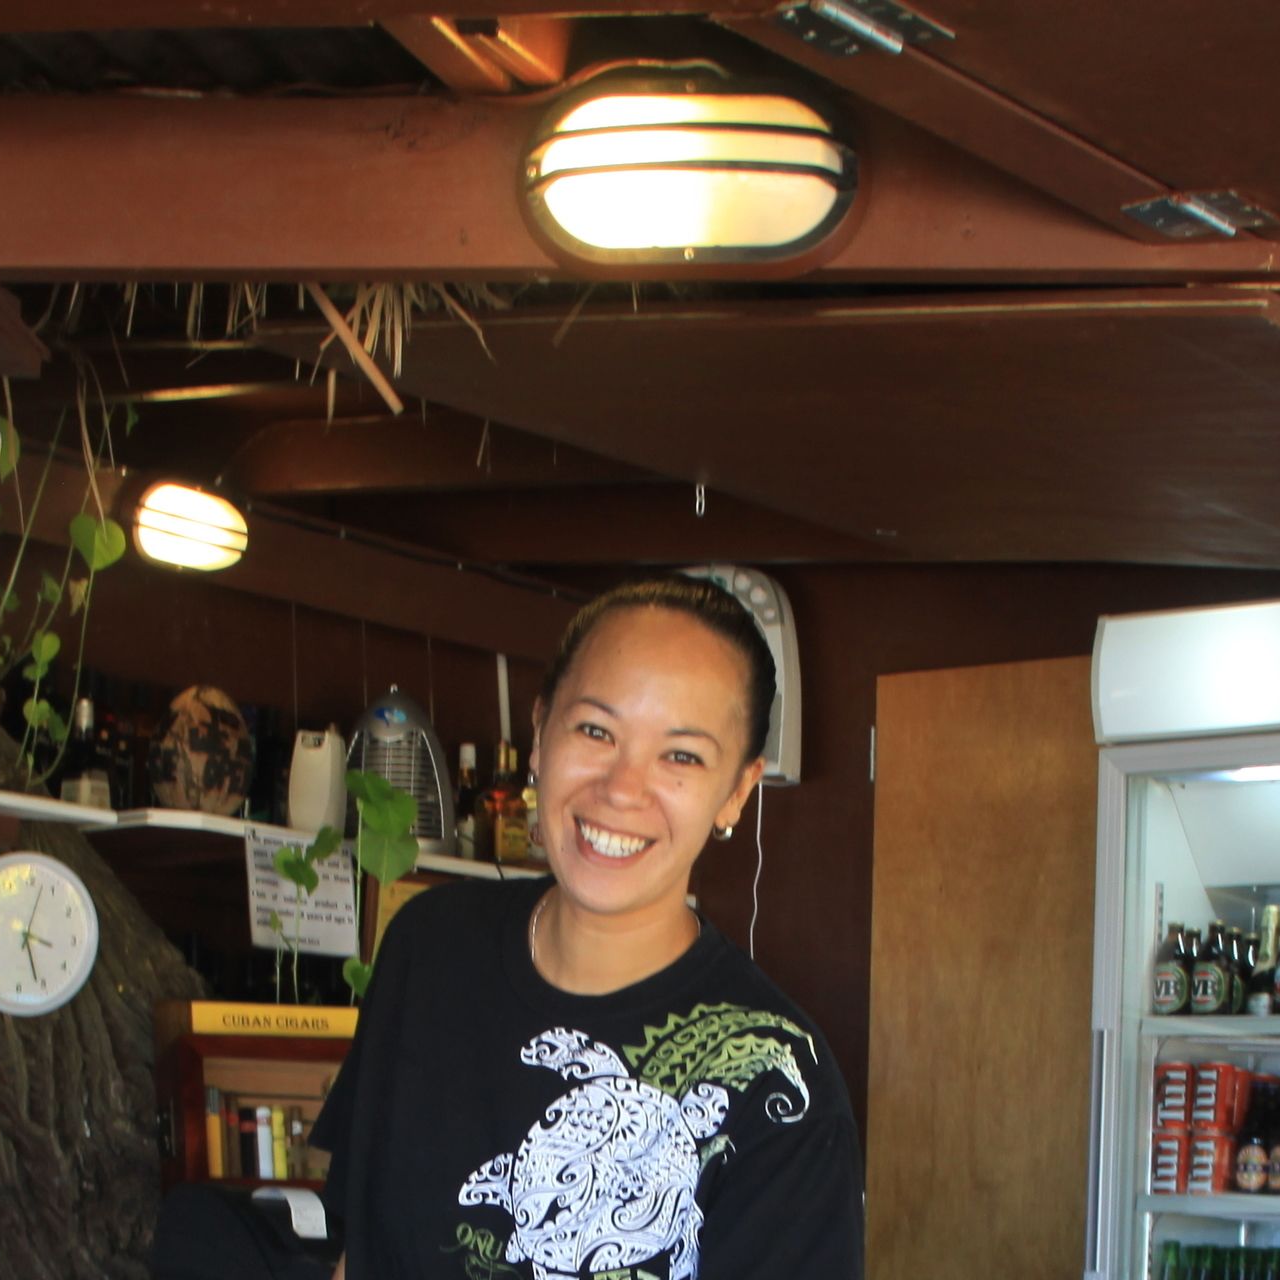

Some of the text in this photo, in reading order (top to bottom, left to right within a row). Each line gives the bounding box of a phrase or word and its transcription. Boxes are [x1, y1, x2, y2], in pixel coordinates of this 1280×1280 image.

[1153, 978, 1179, 998] VB
[1192, 978, 1218, 998] VB
[221, 1014, 330, 1031] CUBAN CIGARS
[1157, 1070, 1187, 1127] Tui
[1192, 1070, 1218, 1126] Tui
